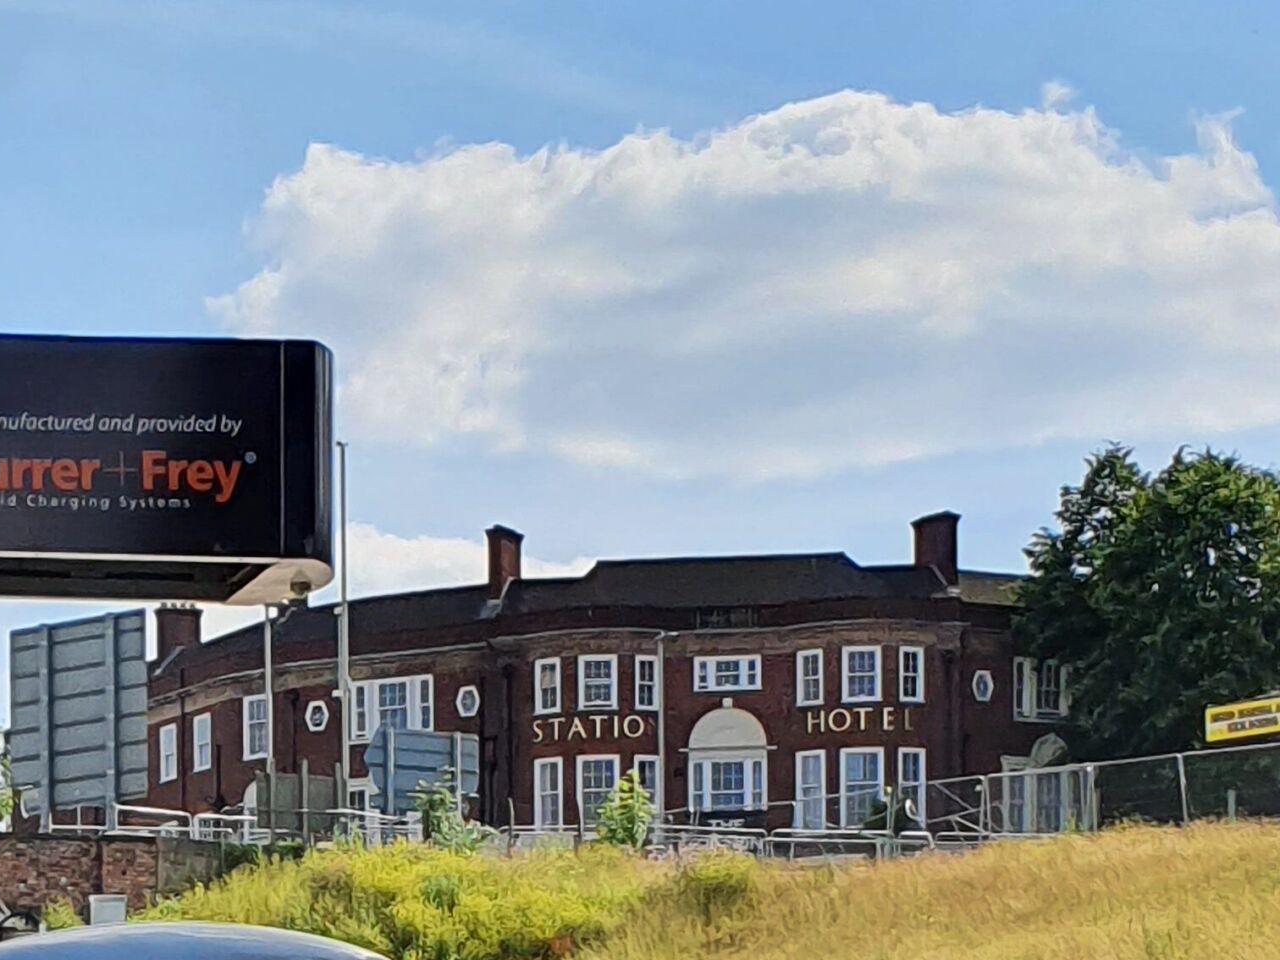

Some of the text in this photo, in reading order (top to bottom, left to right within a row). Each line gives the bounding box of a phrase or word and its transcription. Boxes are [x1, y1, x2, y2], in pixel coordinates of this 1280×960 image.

[98, 414, 133, 432] and
[136, 414, 217, 436] provided
[220, 415, 242, 437] by
[26, 494, 111, 511] Charging
[120, 495, 191, 510] Systems
[807, 706, 914, 734] HOTEL
